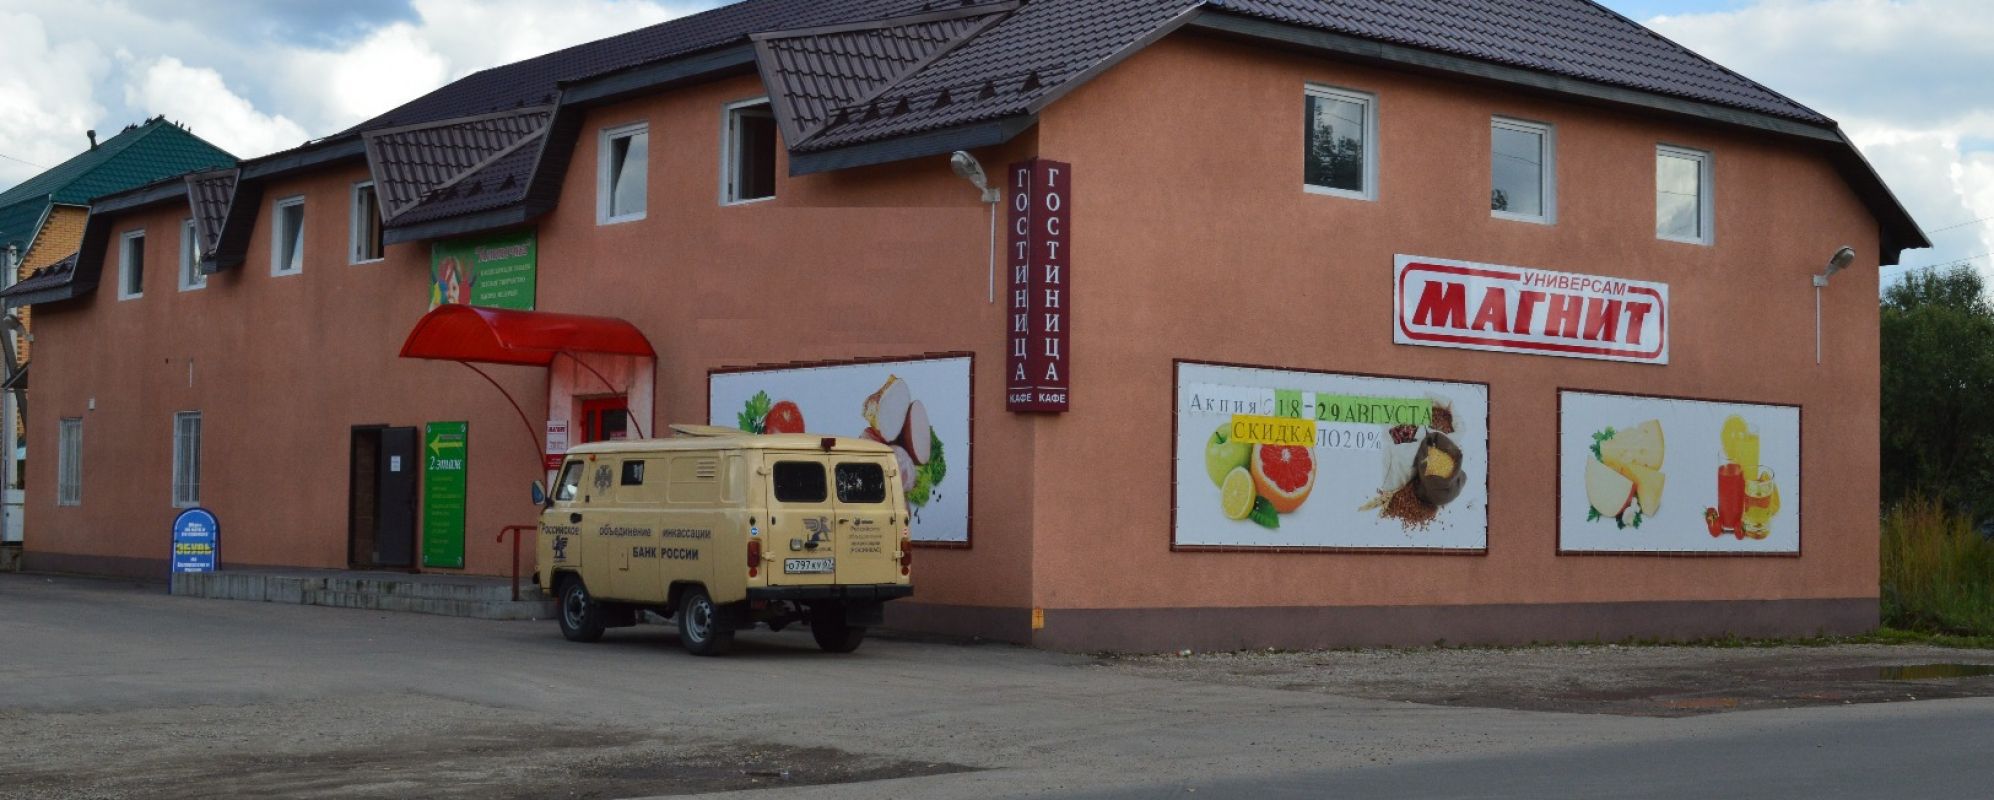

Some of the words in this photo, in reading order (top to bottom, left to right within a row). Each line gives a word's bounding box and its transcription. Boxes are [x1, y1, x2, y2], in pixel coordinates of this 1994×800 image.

[1015, 168, 1028, 382] ГОСТИНИЦА
[1045, 168, 1061, 382] ГОСТИНИЦА
[1522, 272, 1627, 297] УНИВЕРСАМ
[1412, 280, 1652, 346] МАГНИТ
[1009, 393, 1033, 404] КАФЕ
[1038, 393, 1067, 405] КАФЕ
[1233, 421, 1315, 444] СКИДКА
[429, 456, 436, 471] 2
[541, 524, 580, 536] Российское
[599, 524, 651, 538] объединение
[662, 528, 712, 541] инкассации
[633, 546, 656, 558] БАНК
[661, 547, 699, 560] РОССИИ
